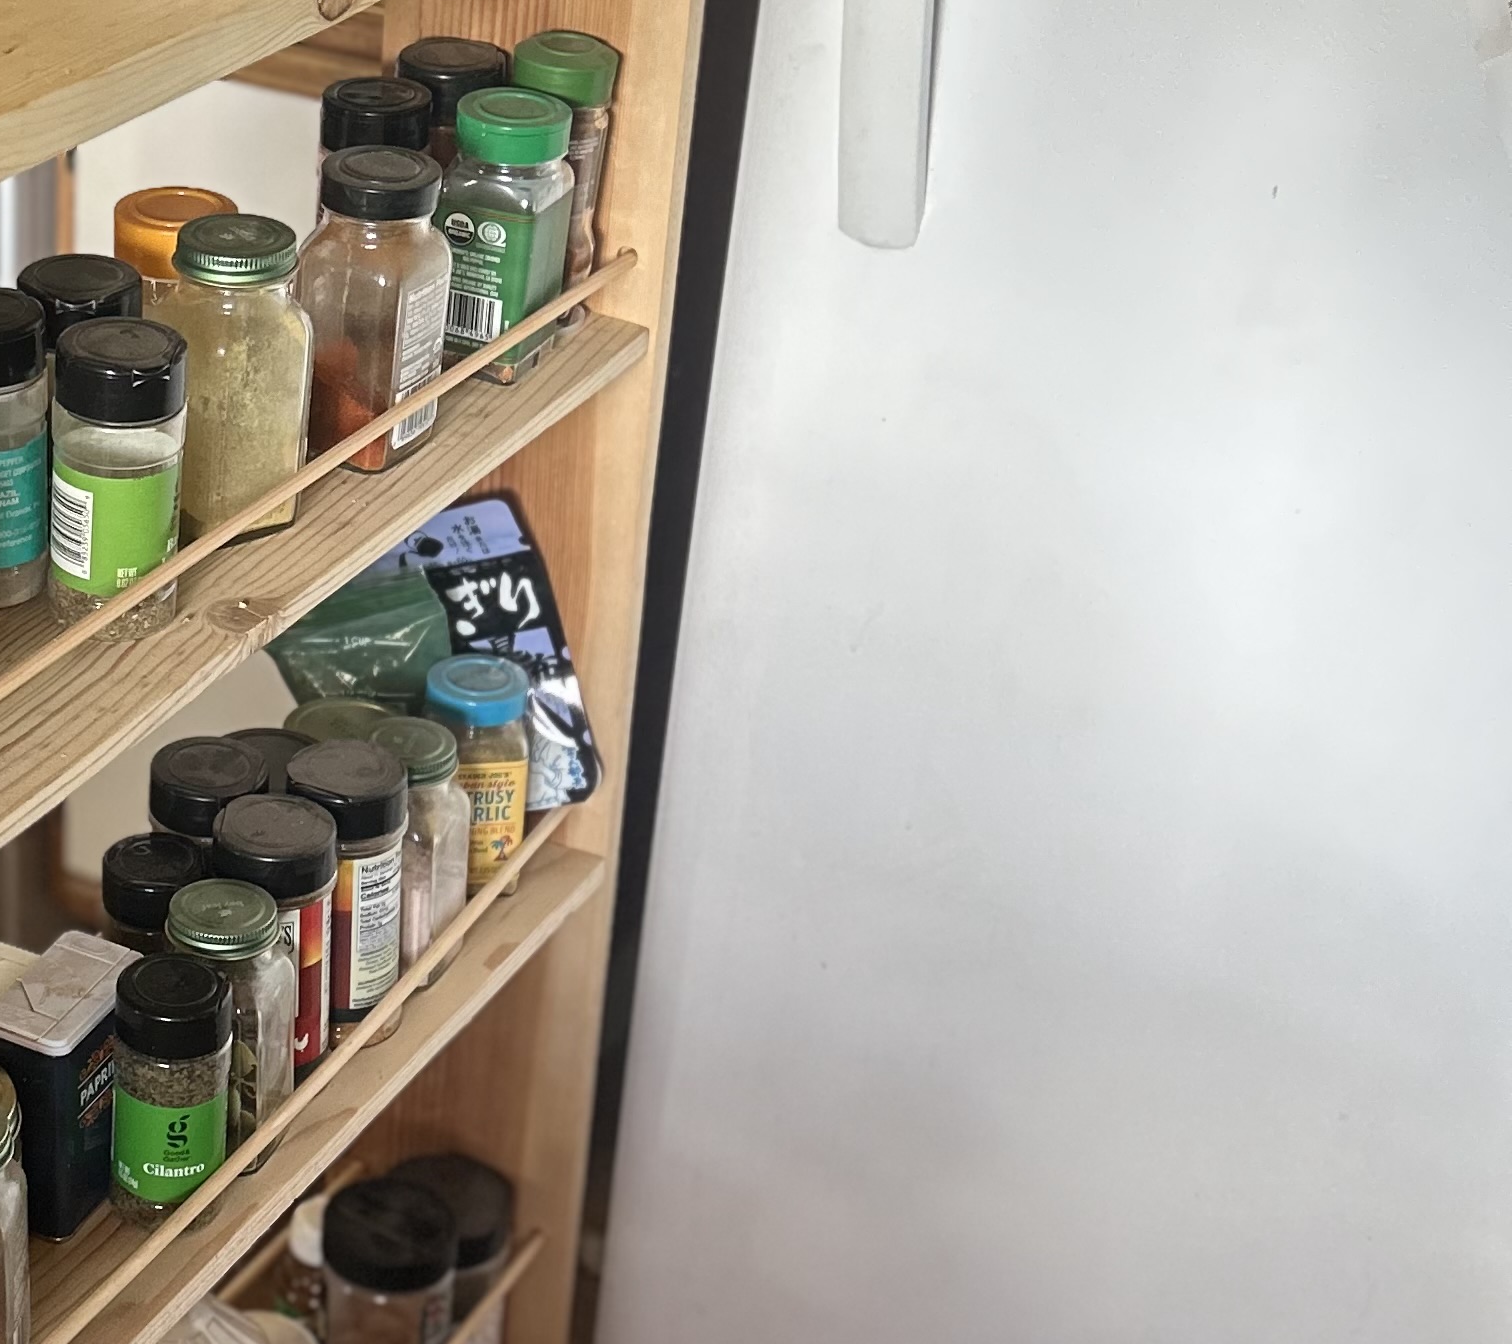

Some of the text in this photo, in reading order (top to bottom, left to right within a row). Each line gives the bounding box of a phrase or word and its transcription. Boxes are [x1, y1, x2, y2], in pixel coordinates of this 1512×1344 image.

[450, 218, 470, 229] USDA
[488, 778, 516, 790] style
[470, 805, 512, 825] RLIC
[361, 857, 396, 874] Nutrition
[142, 1162, 206, 1178] Cilantro
